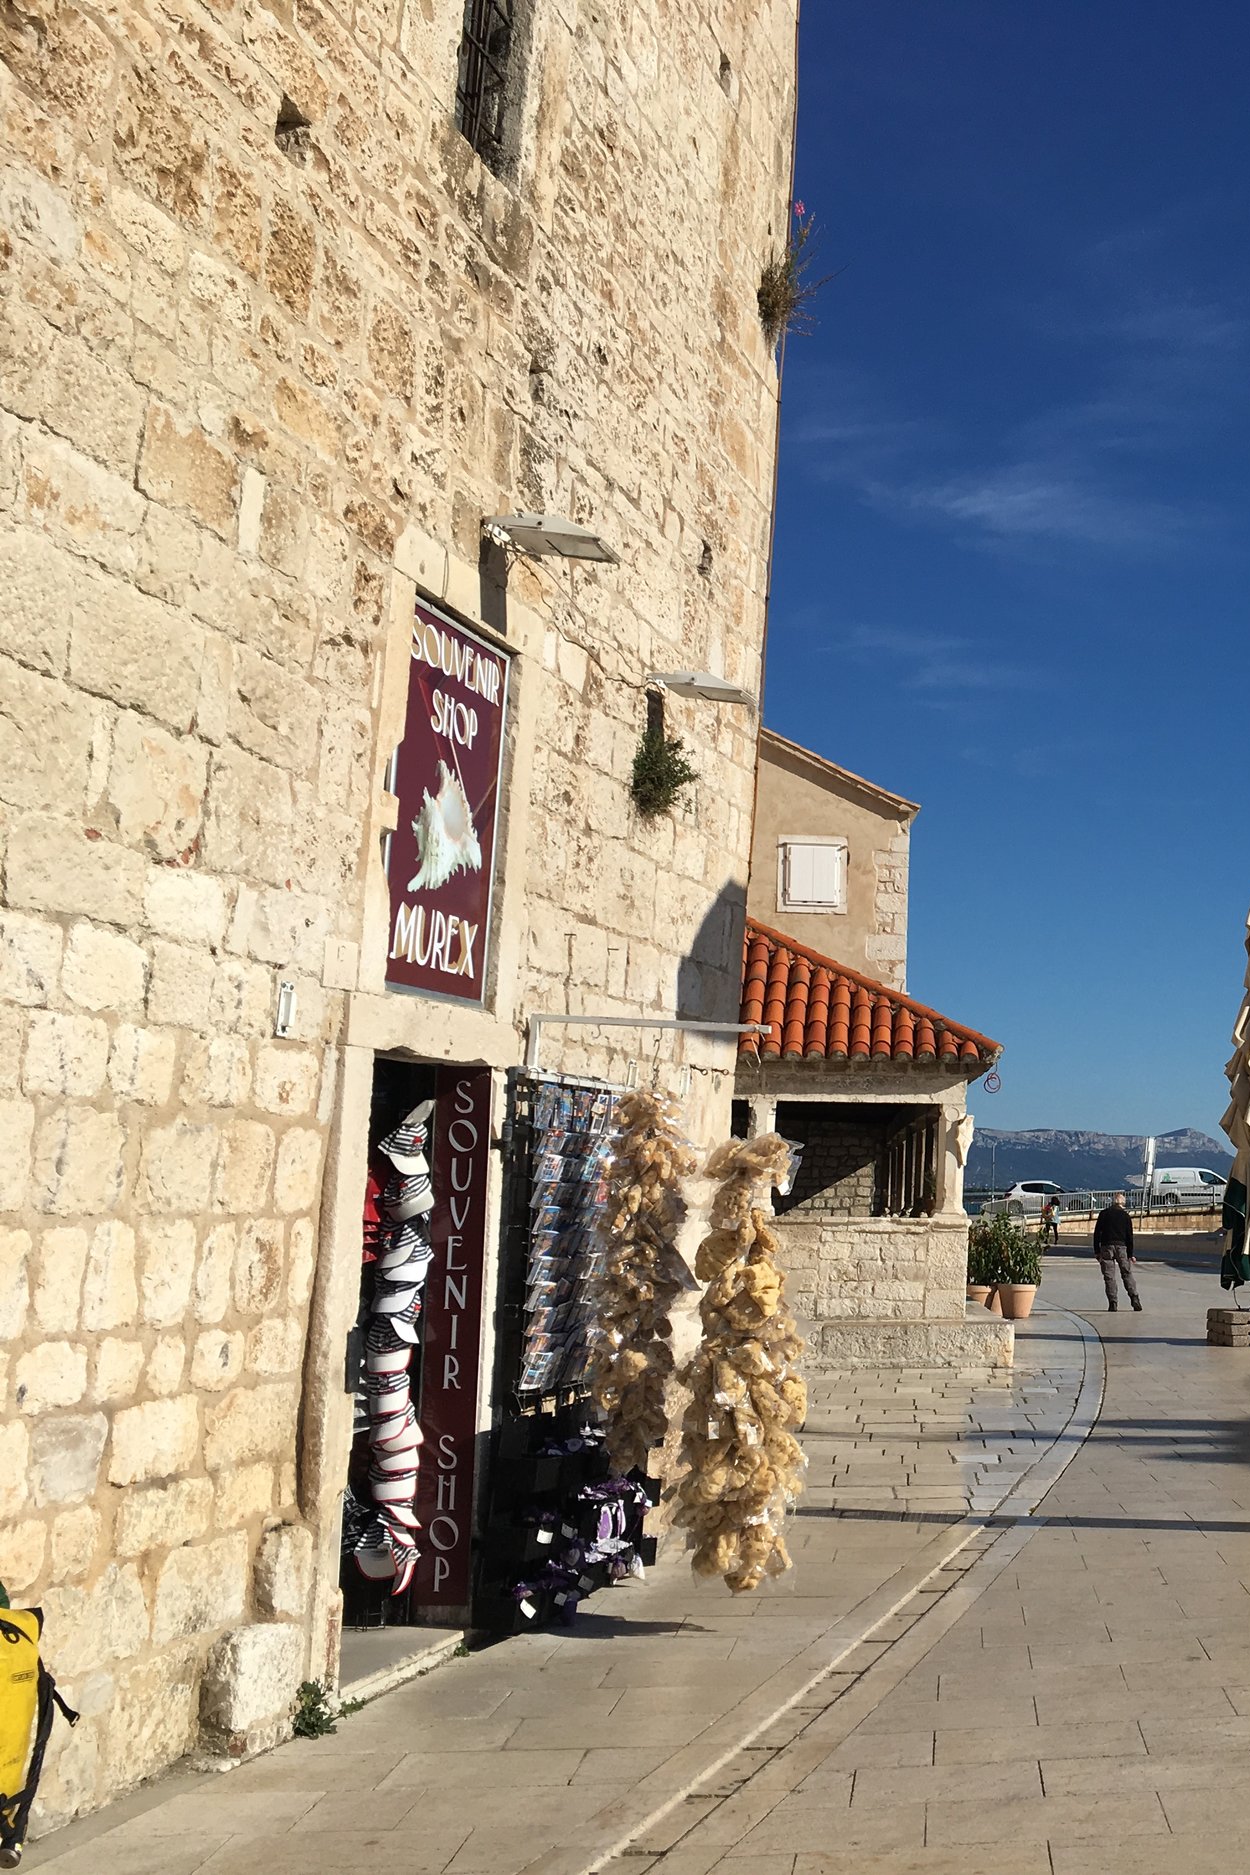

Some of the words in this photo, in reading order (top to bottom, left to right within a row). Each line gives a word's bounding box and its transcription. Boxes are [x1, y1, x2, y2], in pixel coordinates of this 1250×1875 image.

[411, 614, 500, 707] SOUVENIR
[430, 688, 478, 751] SHOP
[389, 901, 479, 979] MUREX
[442, 1080, 478, 1390] SOUVENIR
[429, 1434, 459, 1593] SHOP
